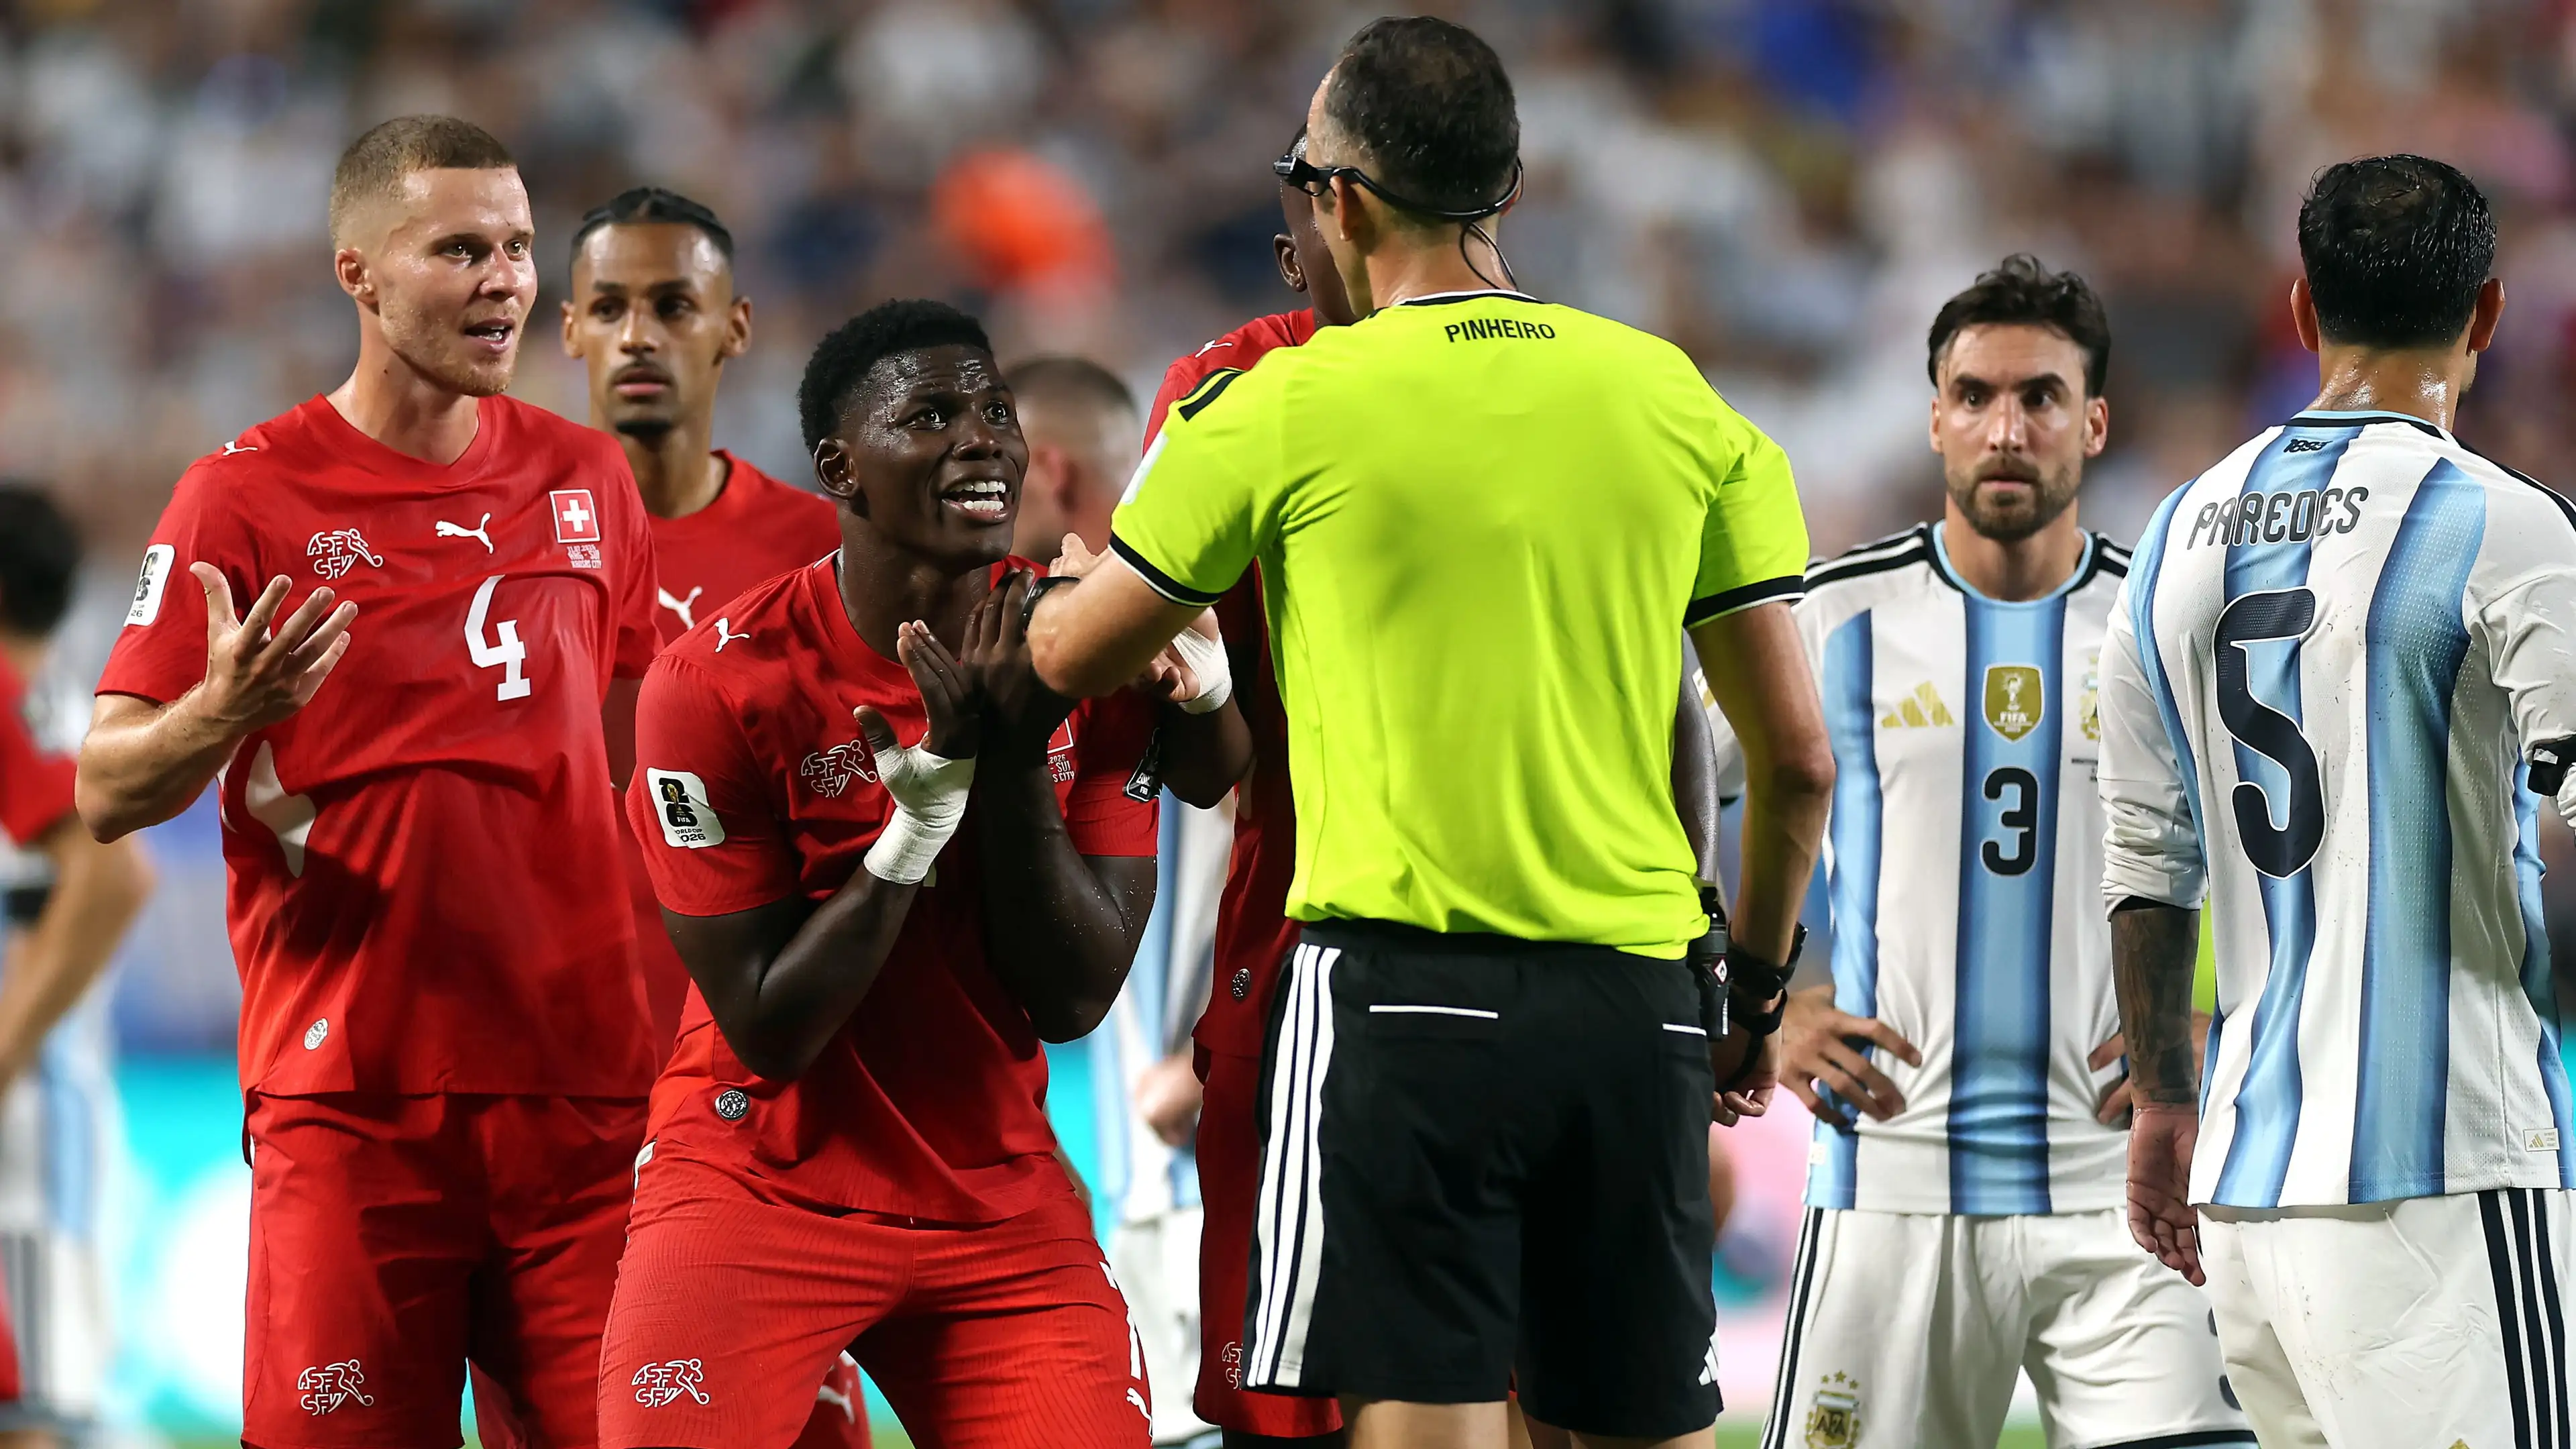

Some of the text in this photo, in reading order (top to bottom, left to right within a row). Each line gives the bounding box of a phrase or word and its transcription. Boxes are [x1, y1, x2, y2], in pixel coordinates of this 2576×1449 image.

[1444, 319, 1556, 343] PINHEIRO
[2186, 486, 2369, 550] PAREDES
[464, 574, 531, 702] 4
[2214, 588, 2326, 880] 5
[1059, 771, 1075, 782] CITY
[680, 833, 706, 843] 026
[1980, 766, 2039, 876] 3
